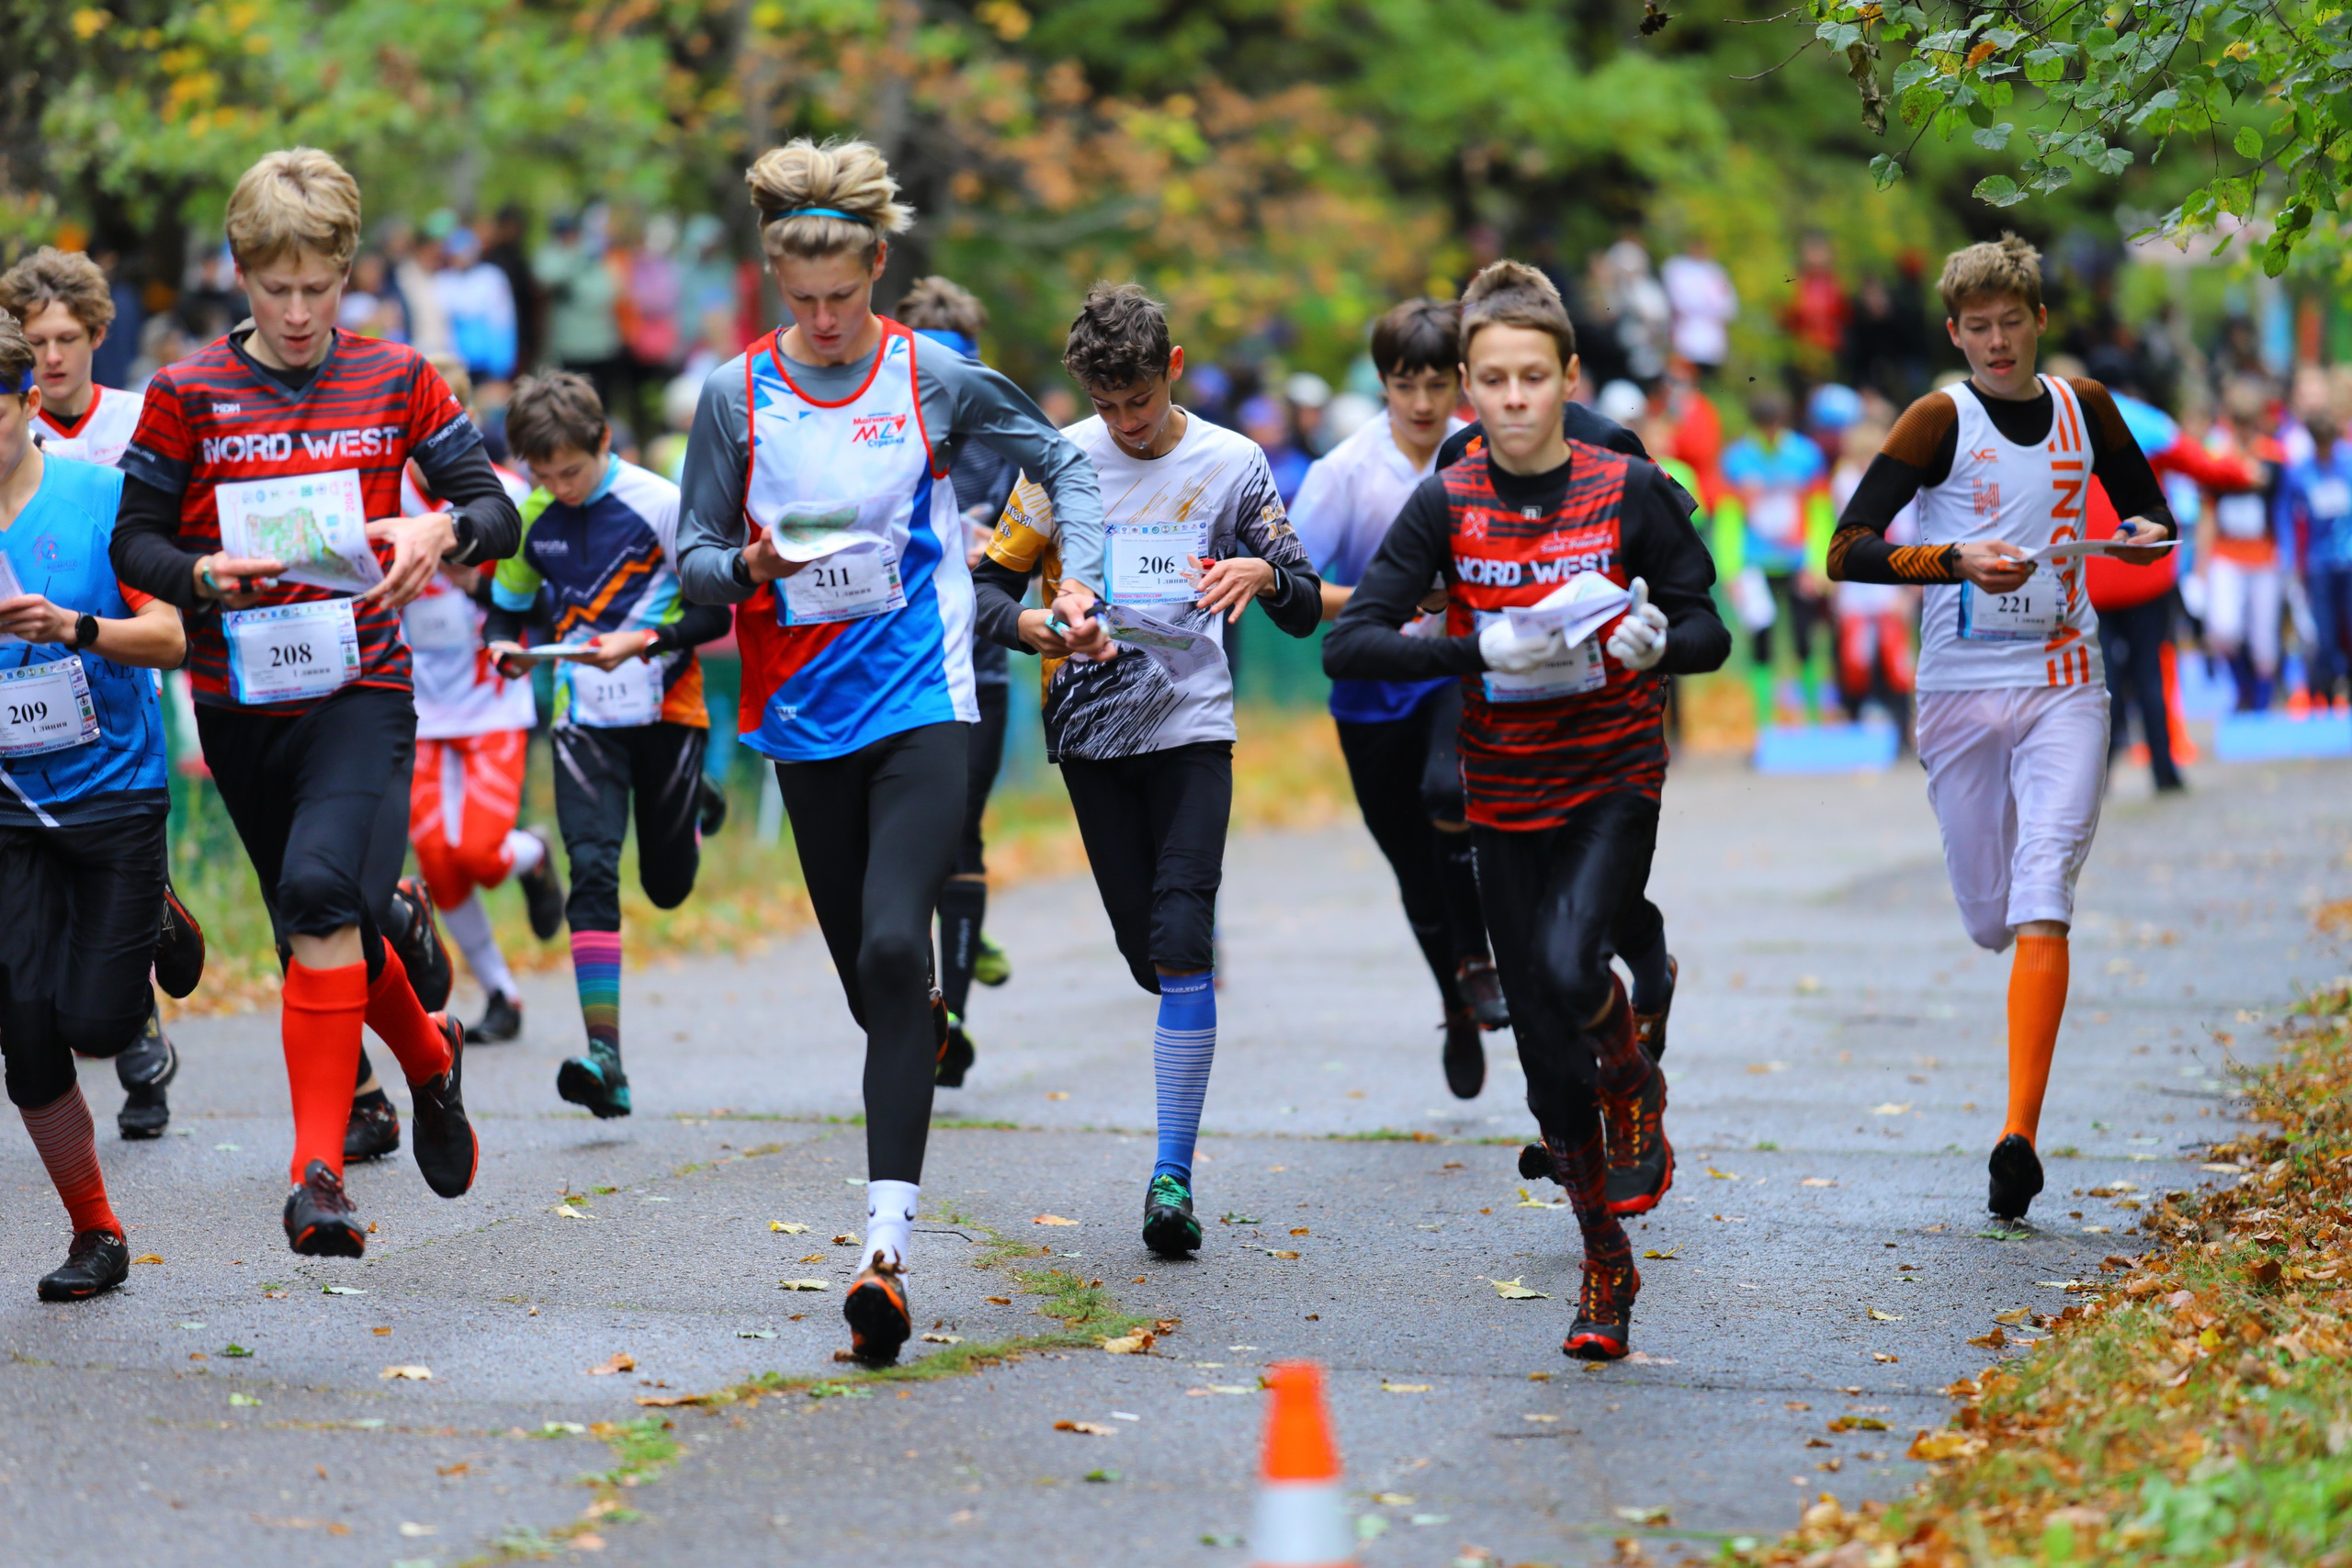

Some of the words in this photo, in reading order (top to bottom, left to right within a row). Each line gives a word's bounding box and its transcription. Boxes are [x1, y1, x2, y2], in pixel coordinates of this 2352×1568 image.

[202, 433, 292, 464] NORD
[300, 426, 399, 459] WEST
[1138, 556, 1175, 574] 206
[1529, 548, 1613, 585] WEST
[813, 567, 850, 587] 211
[1998, 596, 2030, 614] 221
[269, 642, 312, 667] 208
[596, 682, 628, 703] 213
[7, 701, 48, 725] 209
